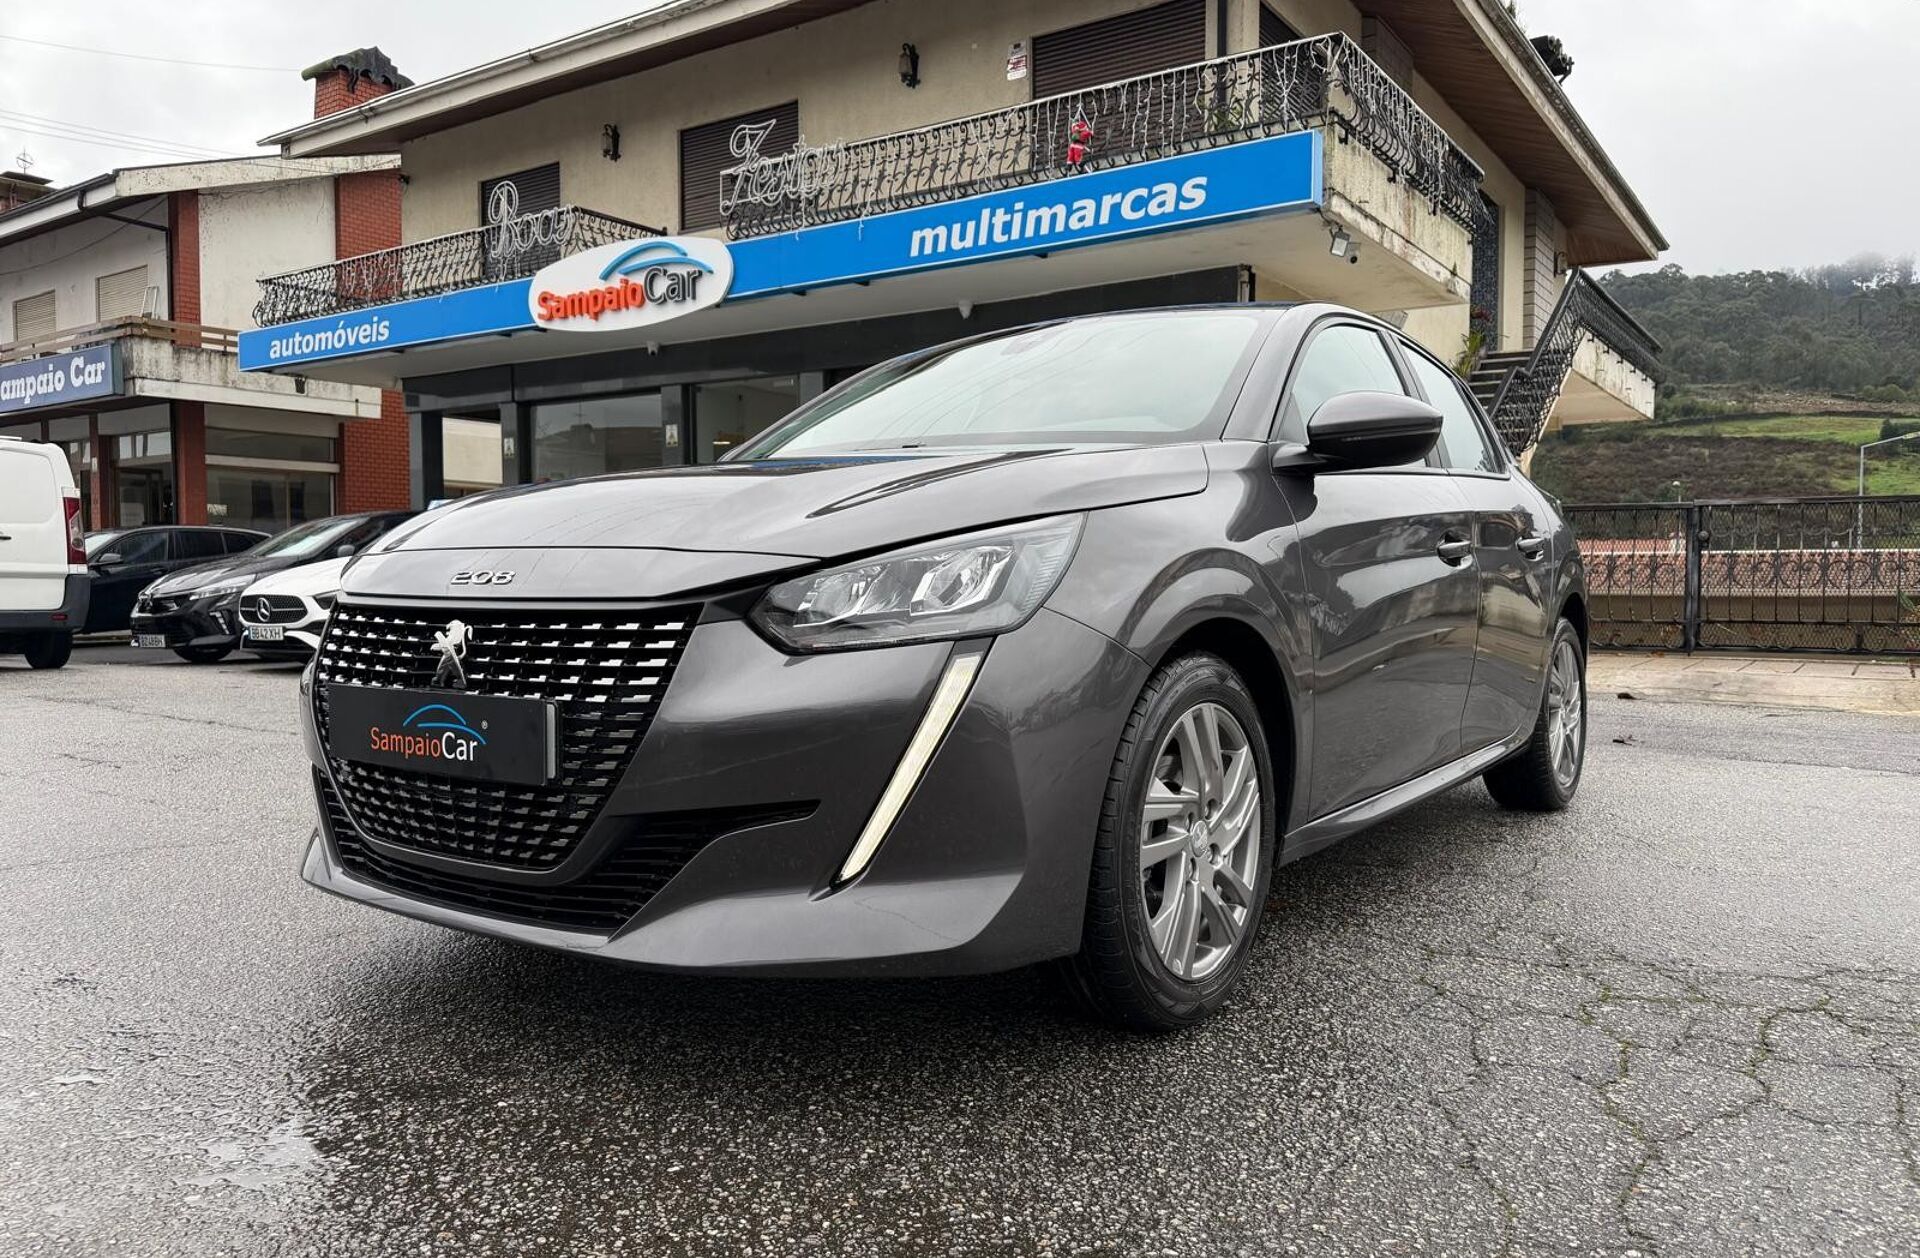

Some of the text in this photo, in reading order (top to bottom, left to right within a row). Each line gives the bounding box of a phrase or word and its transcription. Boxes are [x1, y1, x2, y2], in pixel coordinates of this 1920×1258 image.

[910, 176, 1208, 257] multimarcas
[537, 267, 703, 321] SampaioCar
[269, 316, 390, 359] automóveis
[0, 356, 105, 404] ampaio Car
[450, 570, 517, 586] 208
[370, 727, 478, 761] SampaioCar
